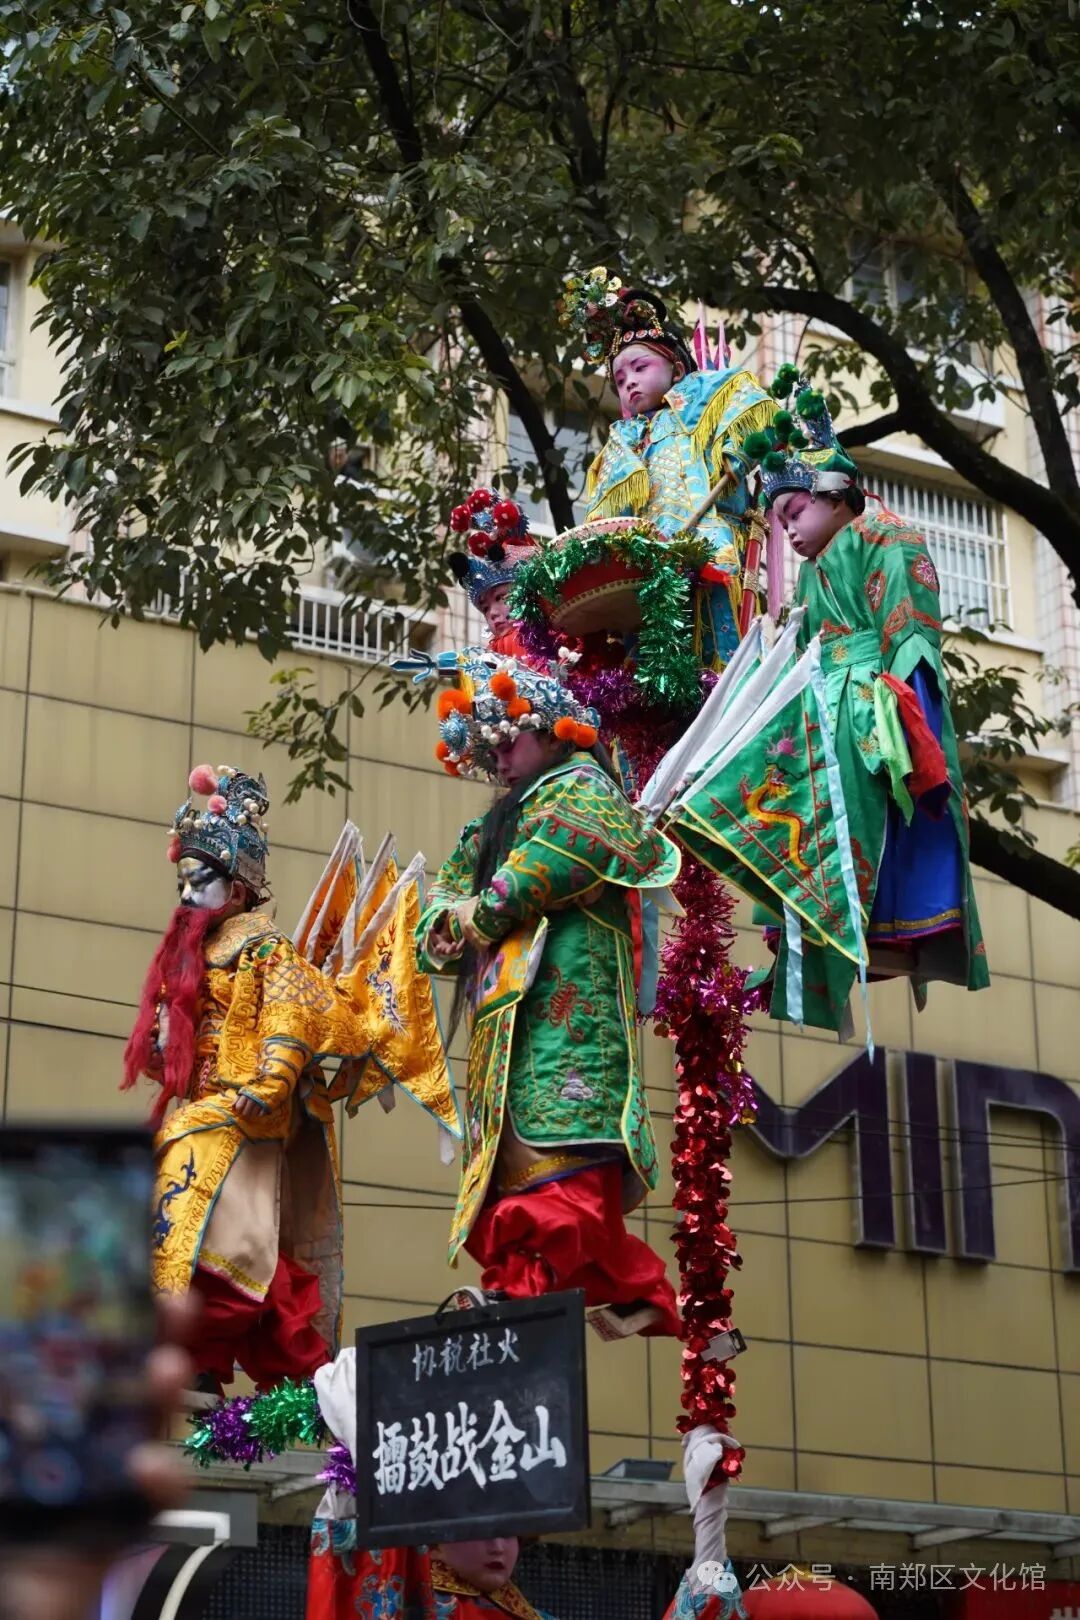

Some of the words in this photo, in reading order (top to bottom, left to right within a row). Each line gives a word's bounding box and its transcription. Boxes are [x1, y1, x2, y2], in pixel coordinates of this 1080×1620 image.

[412, 1327, 521, 1382] 协税社火
[372, 1399, 567, 1496] 擂鼓战金山
